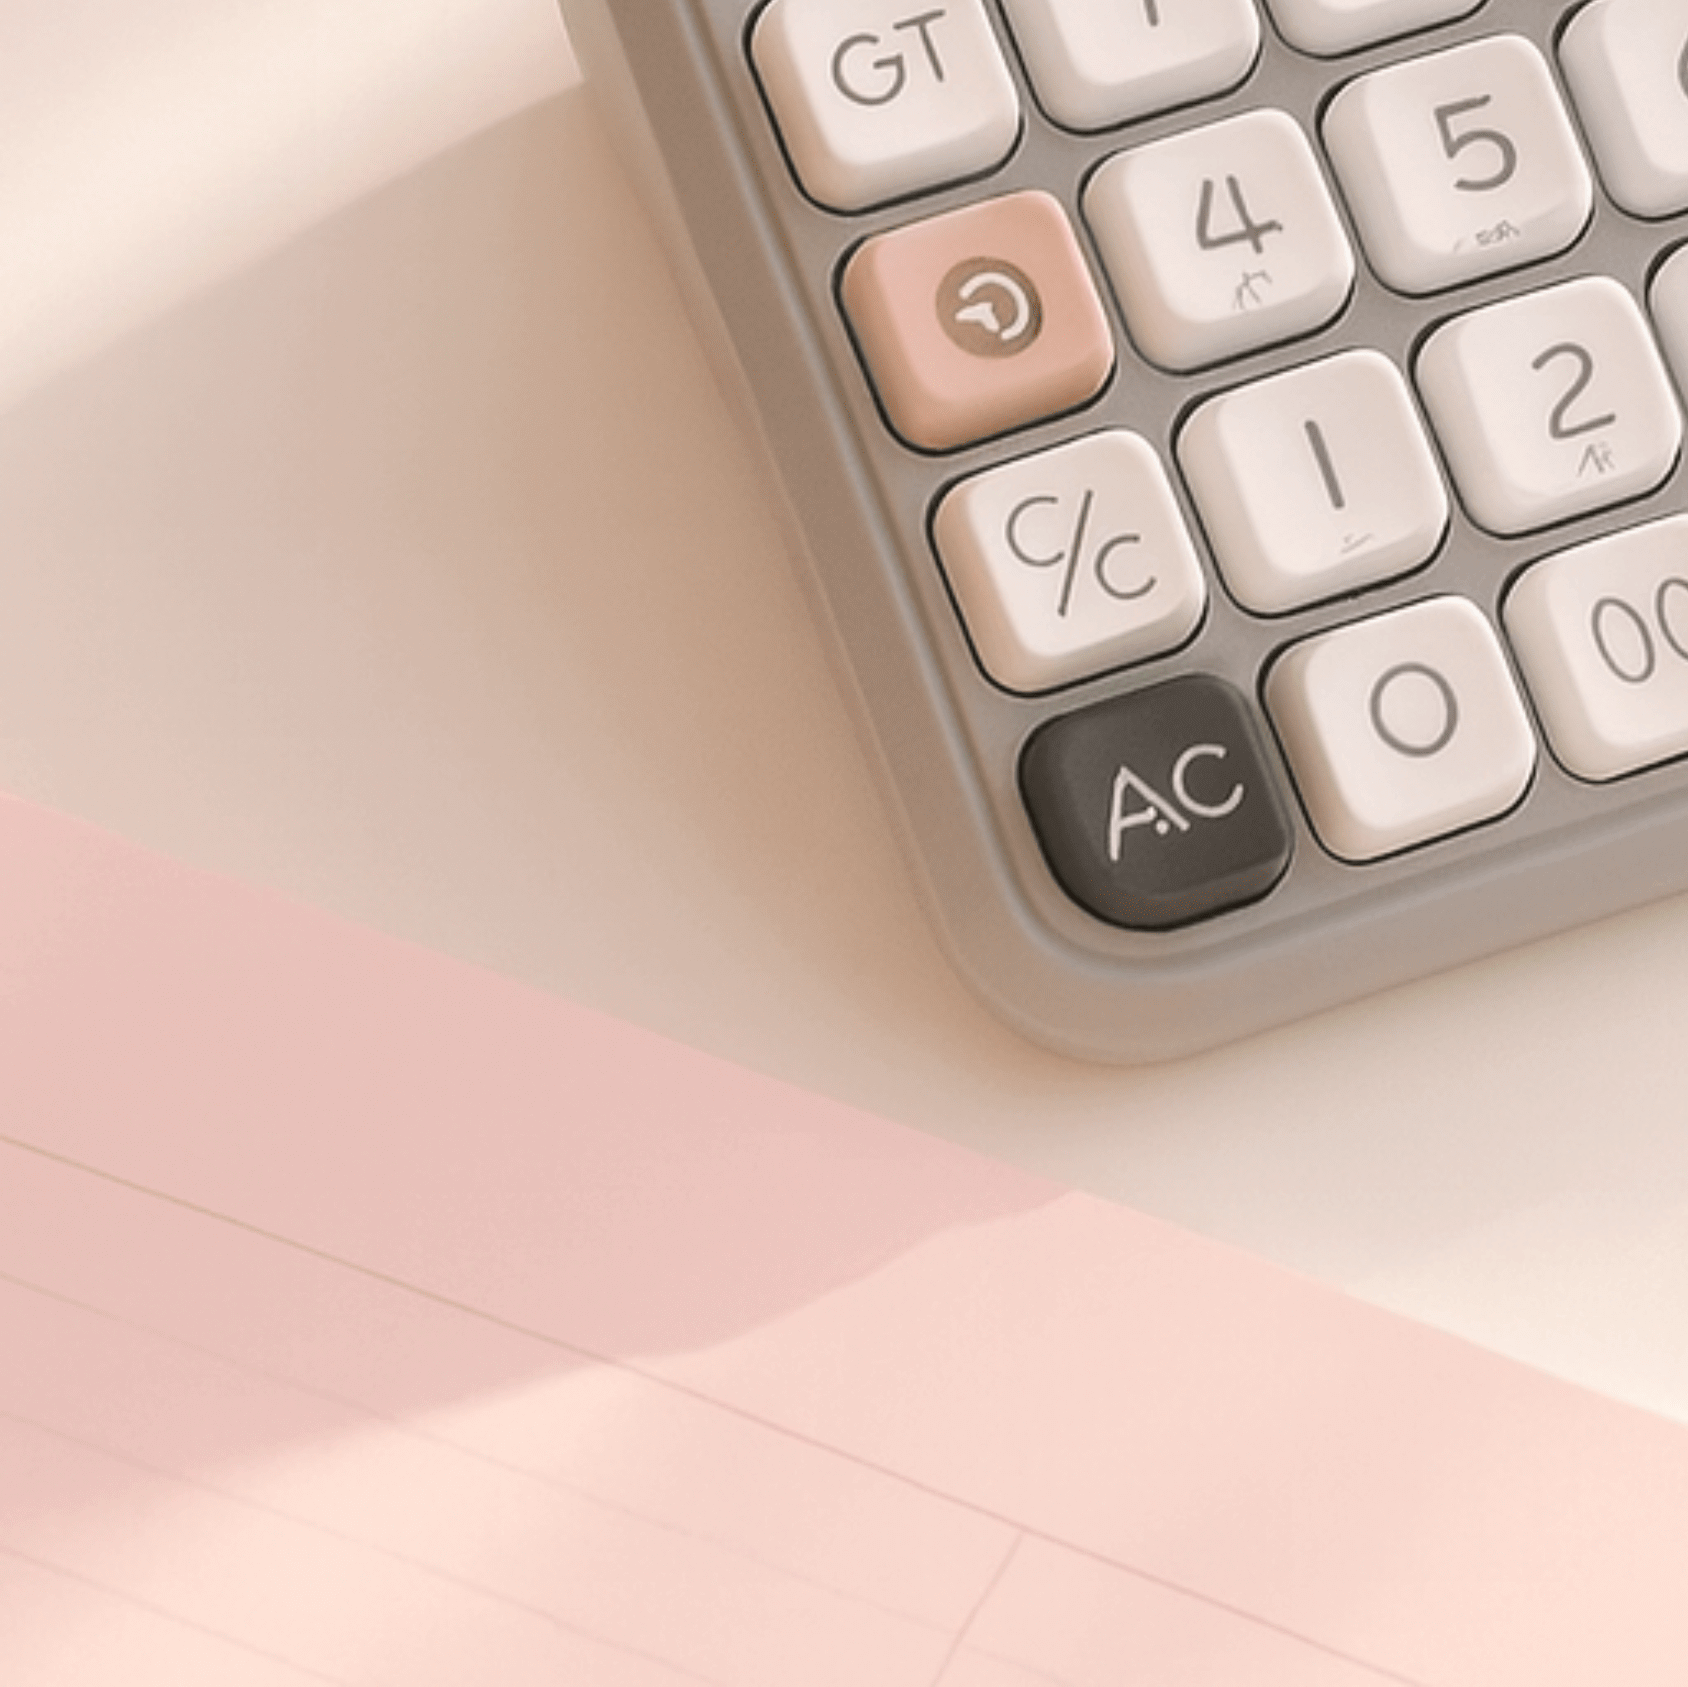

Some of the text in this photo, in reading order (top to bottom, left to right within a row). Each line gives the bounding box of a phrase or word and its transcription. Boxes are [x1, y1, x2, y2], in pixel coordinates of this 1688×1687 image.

[830, 8, 947, 107] GT
[1433, 93, 1518, 192] 5
[1195, 174, 1285, 255] 4
[1531, 341, 1618, 441] 2
